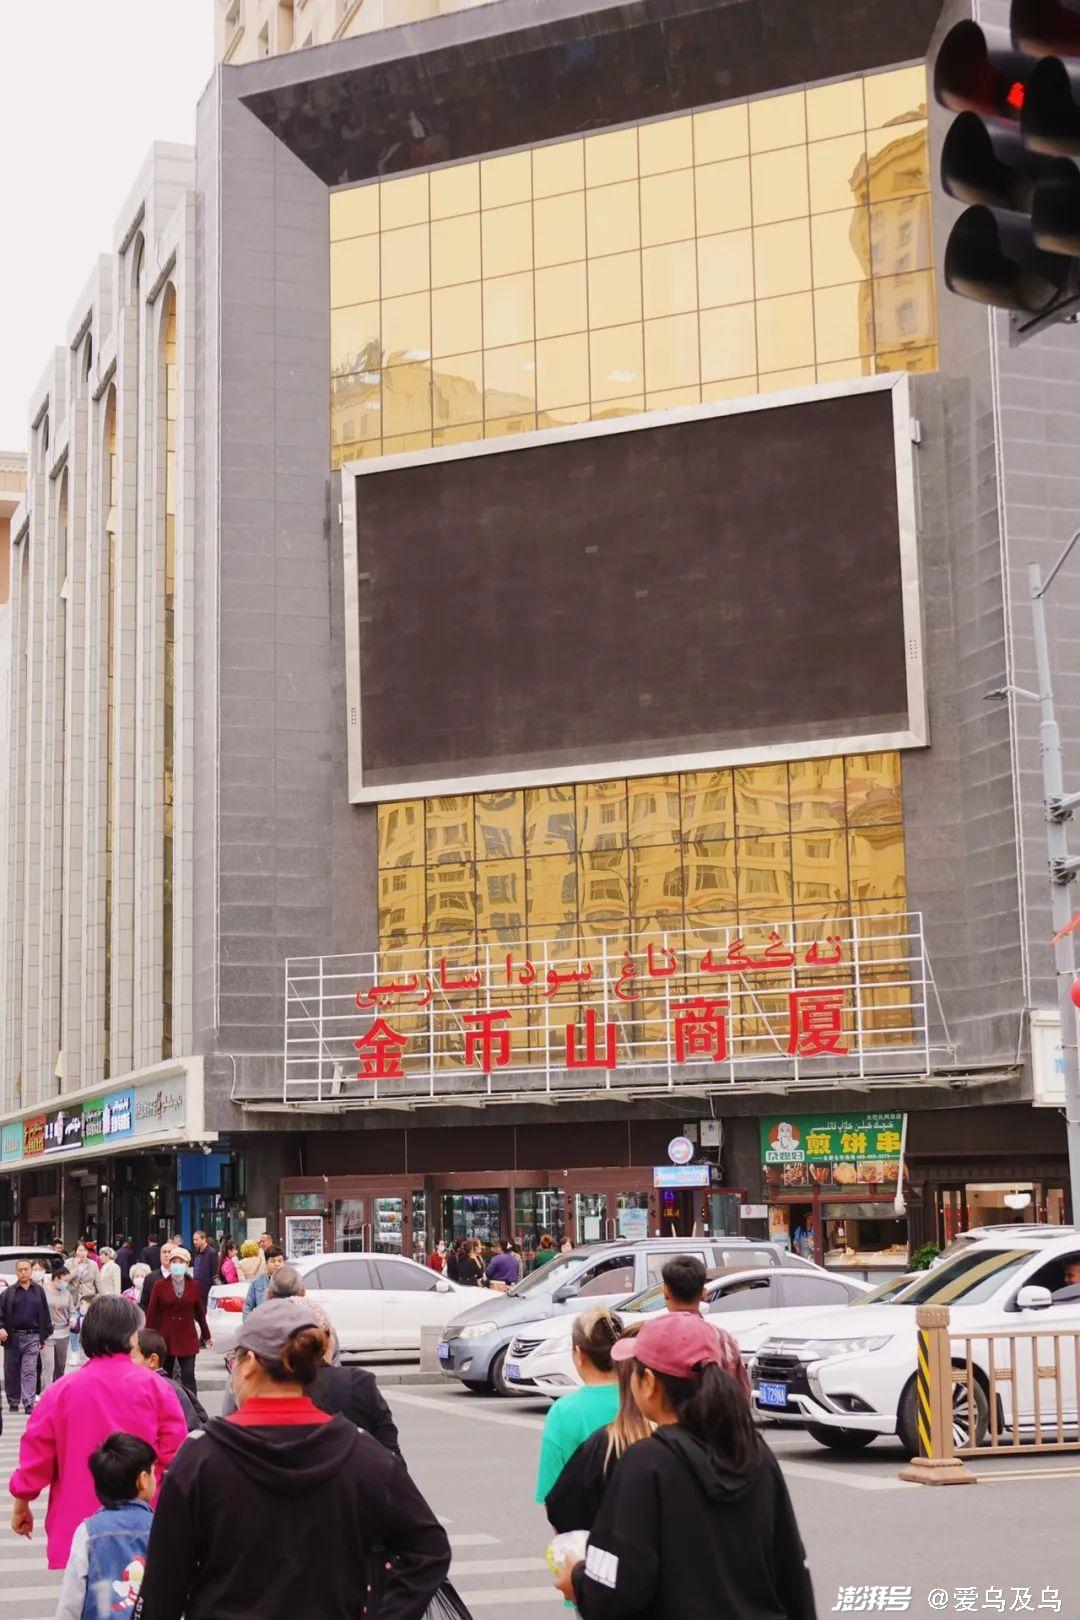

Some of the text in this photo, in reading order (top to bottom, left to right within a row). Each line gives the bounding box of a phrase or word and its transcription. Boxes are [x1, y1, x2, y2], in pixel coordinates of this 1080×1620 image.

[505, 951, 593, 998] سودا
[612, 942, 677, 1002] تاغ
[353, 987, 850, 1080] 金币山商厦
[805, 1131, 901, 1155] 煎饼串
